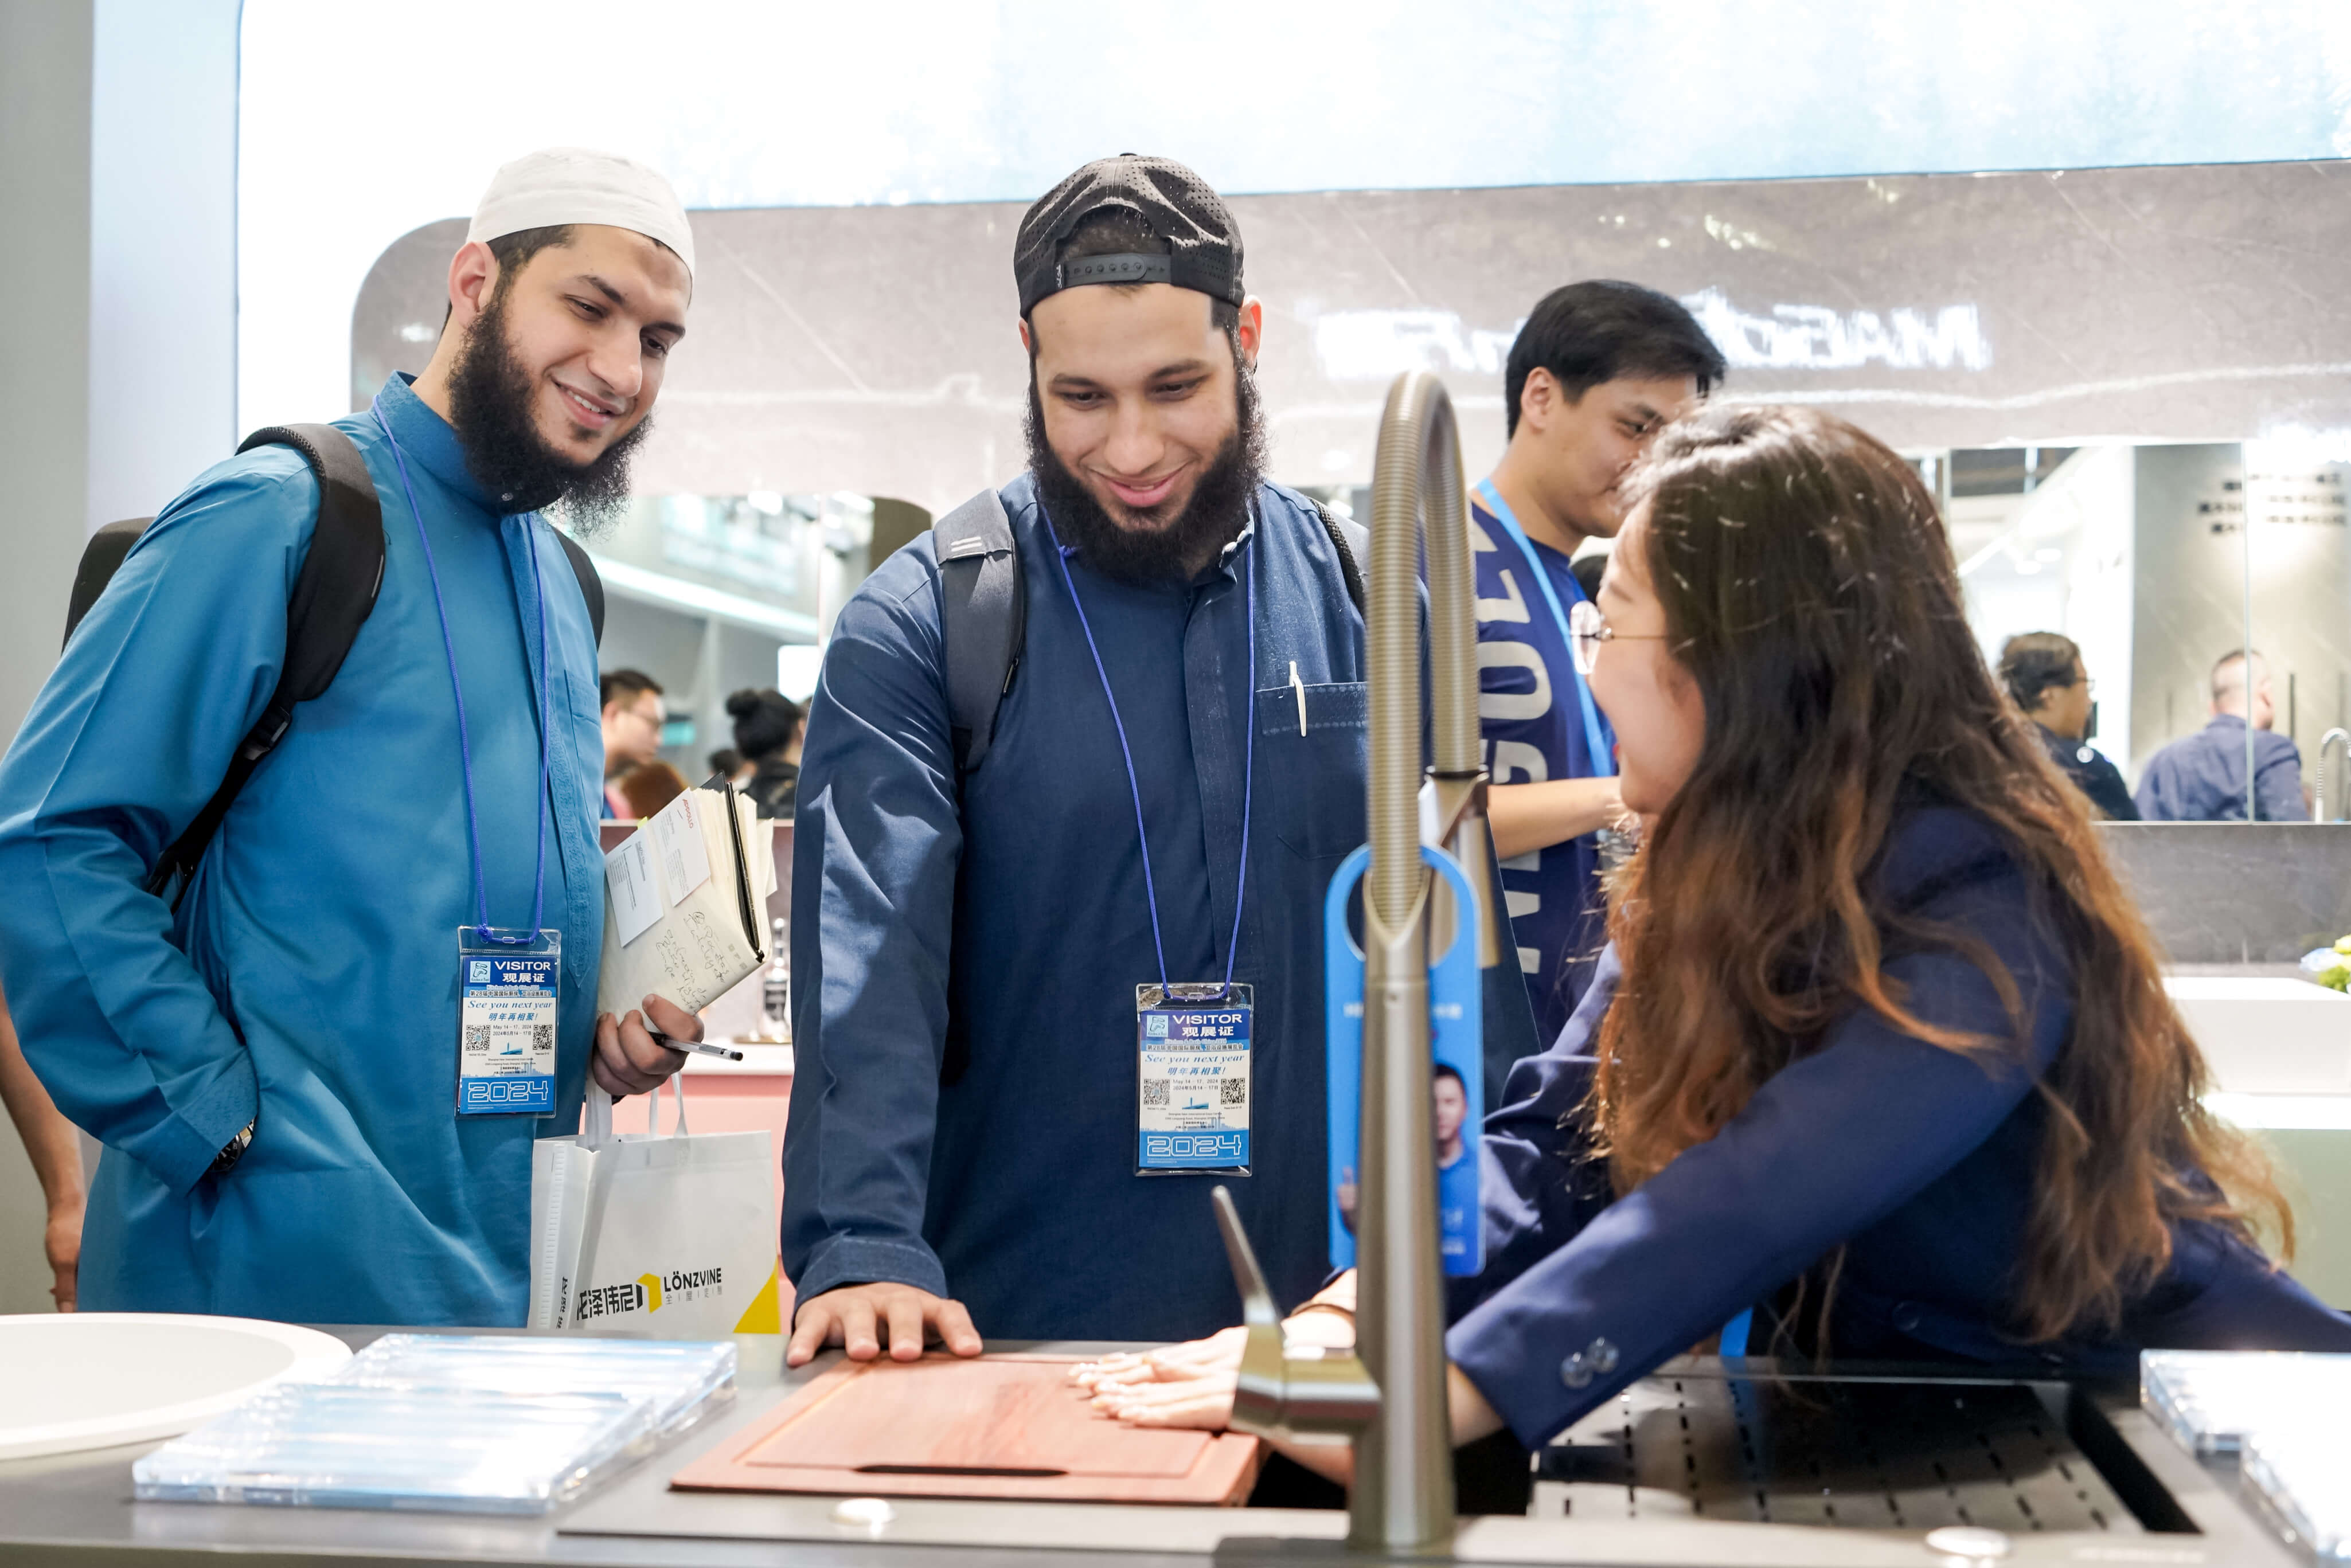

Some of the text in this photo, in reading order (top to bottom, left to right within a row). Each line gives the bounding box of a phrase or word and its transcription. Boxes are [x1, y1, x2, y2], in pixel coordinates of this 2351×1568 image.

[494, 961, 551, 971] VISITOR
[502, 973, 545, 983] 观展证
[1173, 1014, 1243, 1025] VISITOR
[1182, 1026, 1234, 1037] 观展证
[1145, 1054, 1165, 1062] See
[1167, 1057, 1189, 1065] you
[1220, 1055, 1244, 1063] year
[468, 1081, 548, 1102] 2024
[1147, 1135, 1241, 1156] 2024
[663, 1268, 721, 1292] LÖNZVINE
